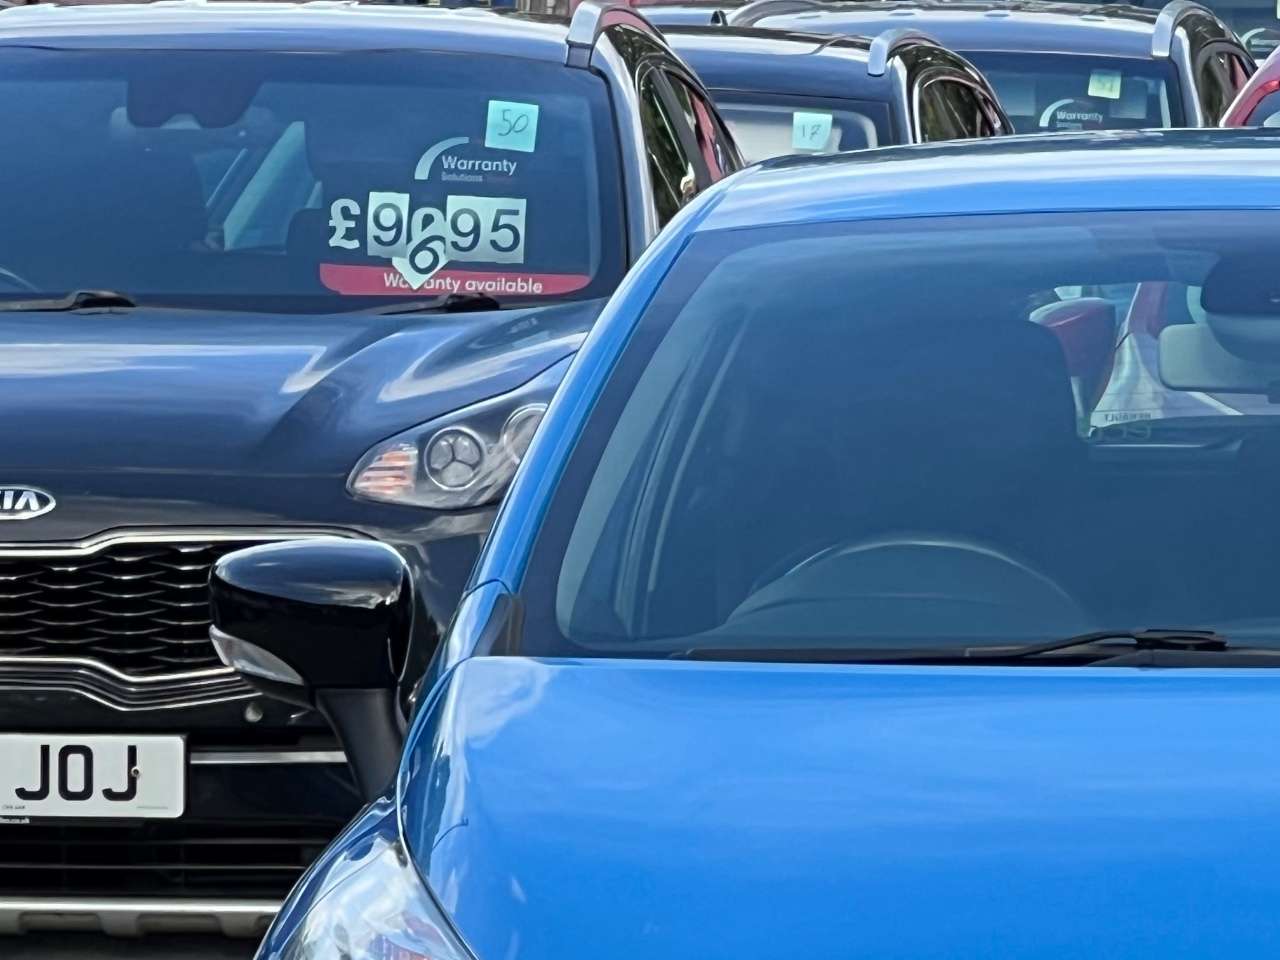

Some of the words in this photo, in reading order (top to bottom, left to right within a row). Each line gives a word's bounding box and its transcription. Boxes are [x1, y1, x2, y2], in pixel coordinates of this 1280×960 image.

[498, 109, 529, 136] 50
[442, 155, 517, 176] Warranty
[383, 272, 461, 293] Waanty
[465, 277, 543, 294] available
[0, 490, 40, 511] IA
[15, 744, 138, 802] JOJ
